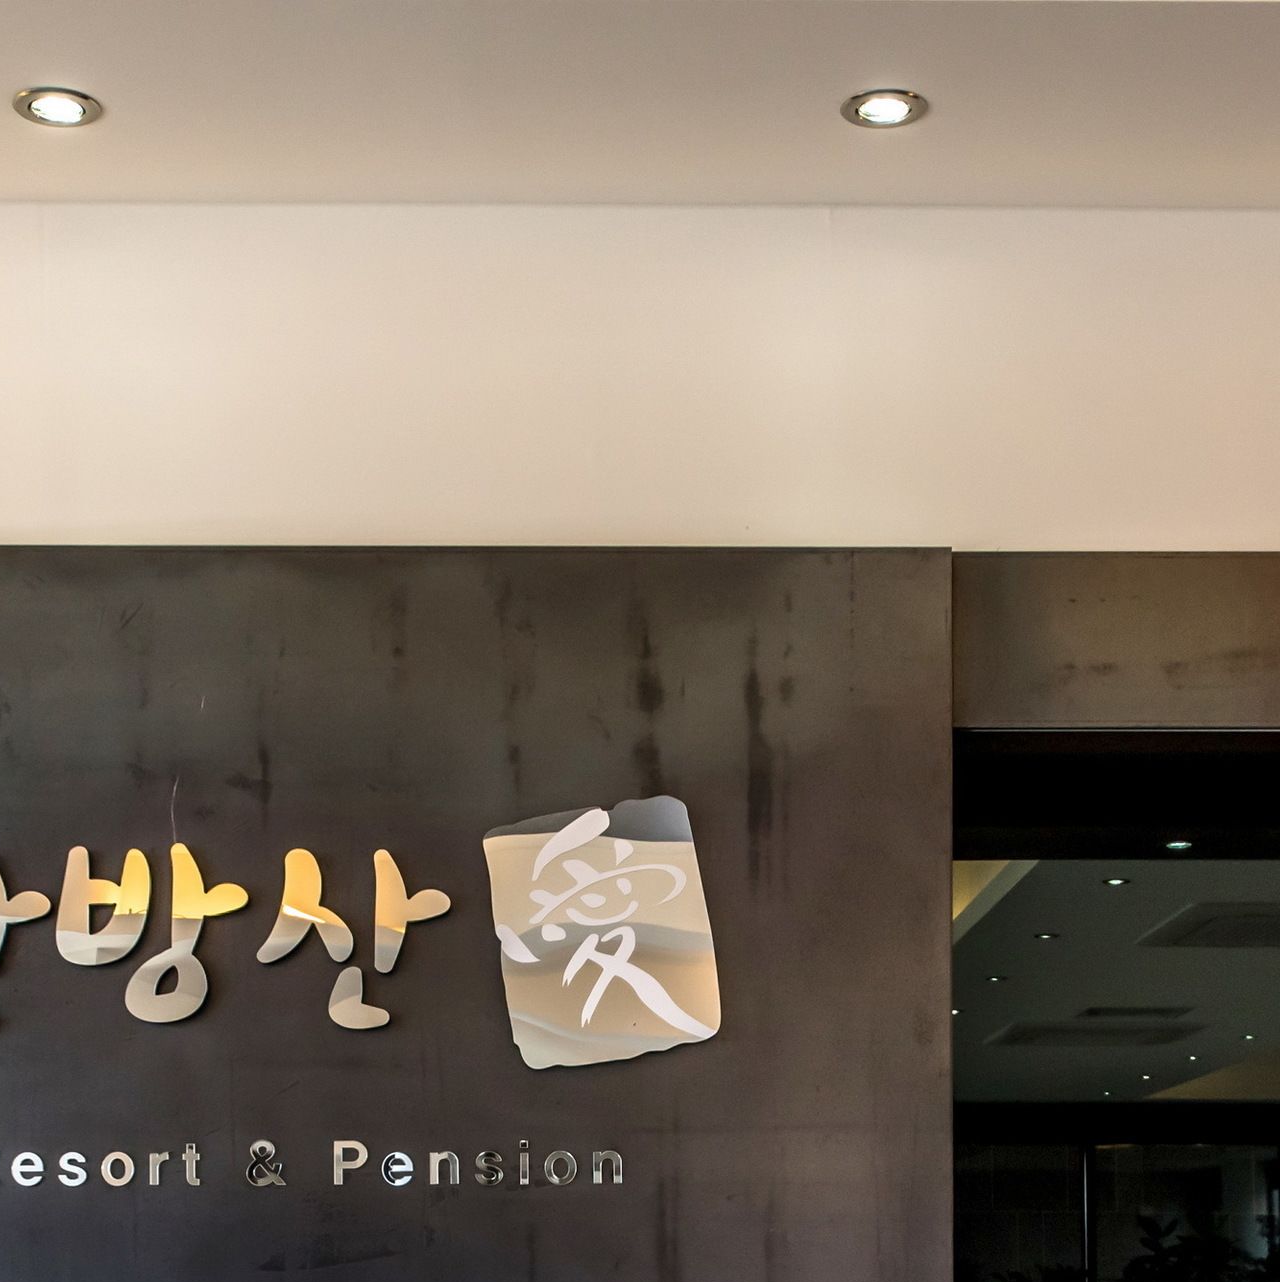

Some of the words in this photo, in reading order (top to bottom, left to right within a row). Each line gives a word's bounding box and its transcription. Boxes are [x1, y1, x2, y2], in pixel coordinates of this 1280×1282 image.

[496, 808, 717, 1039] 愛
[245, 1139, 287, 1187] &
[333, 1139, 623, 1187] Pension
